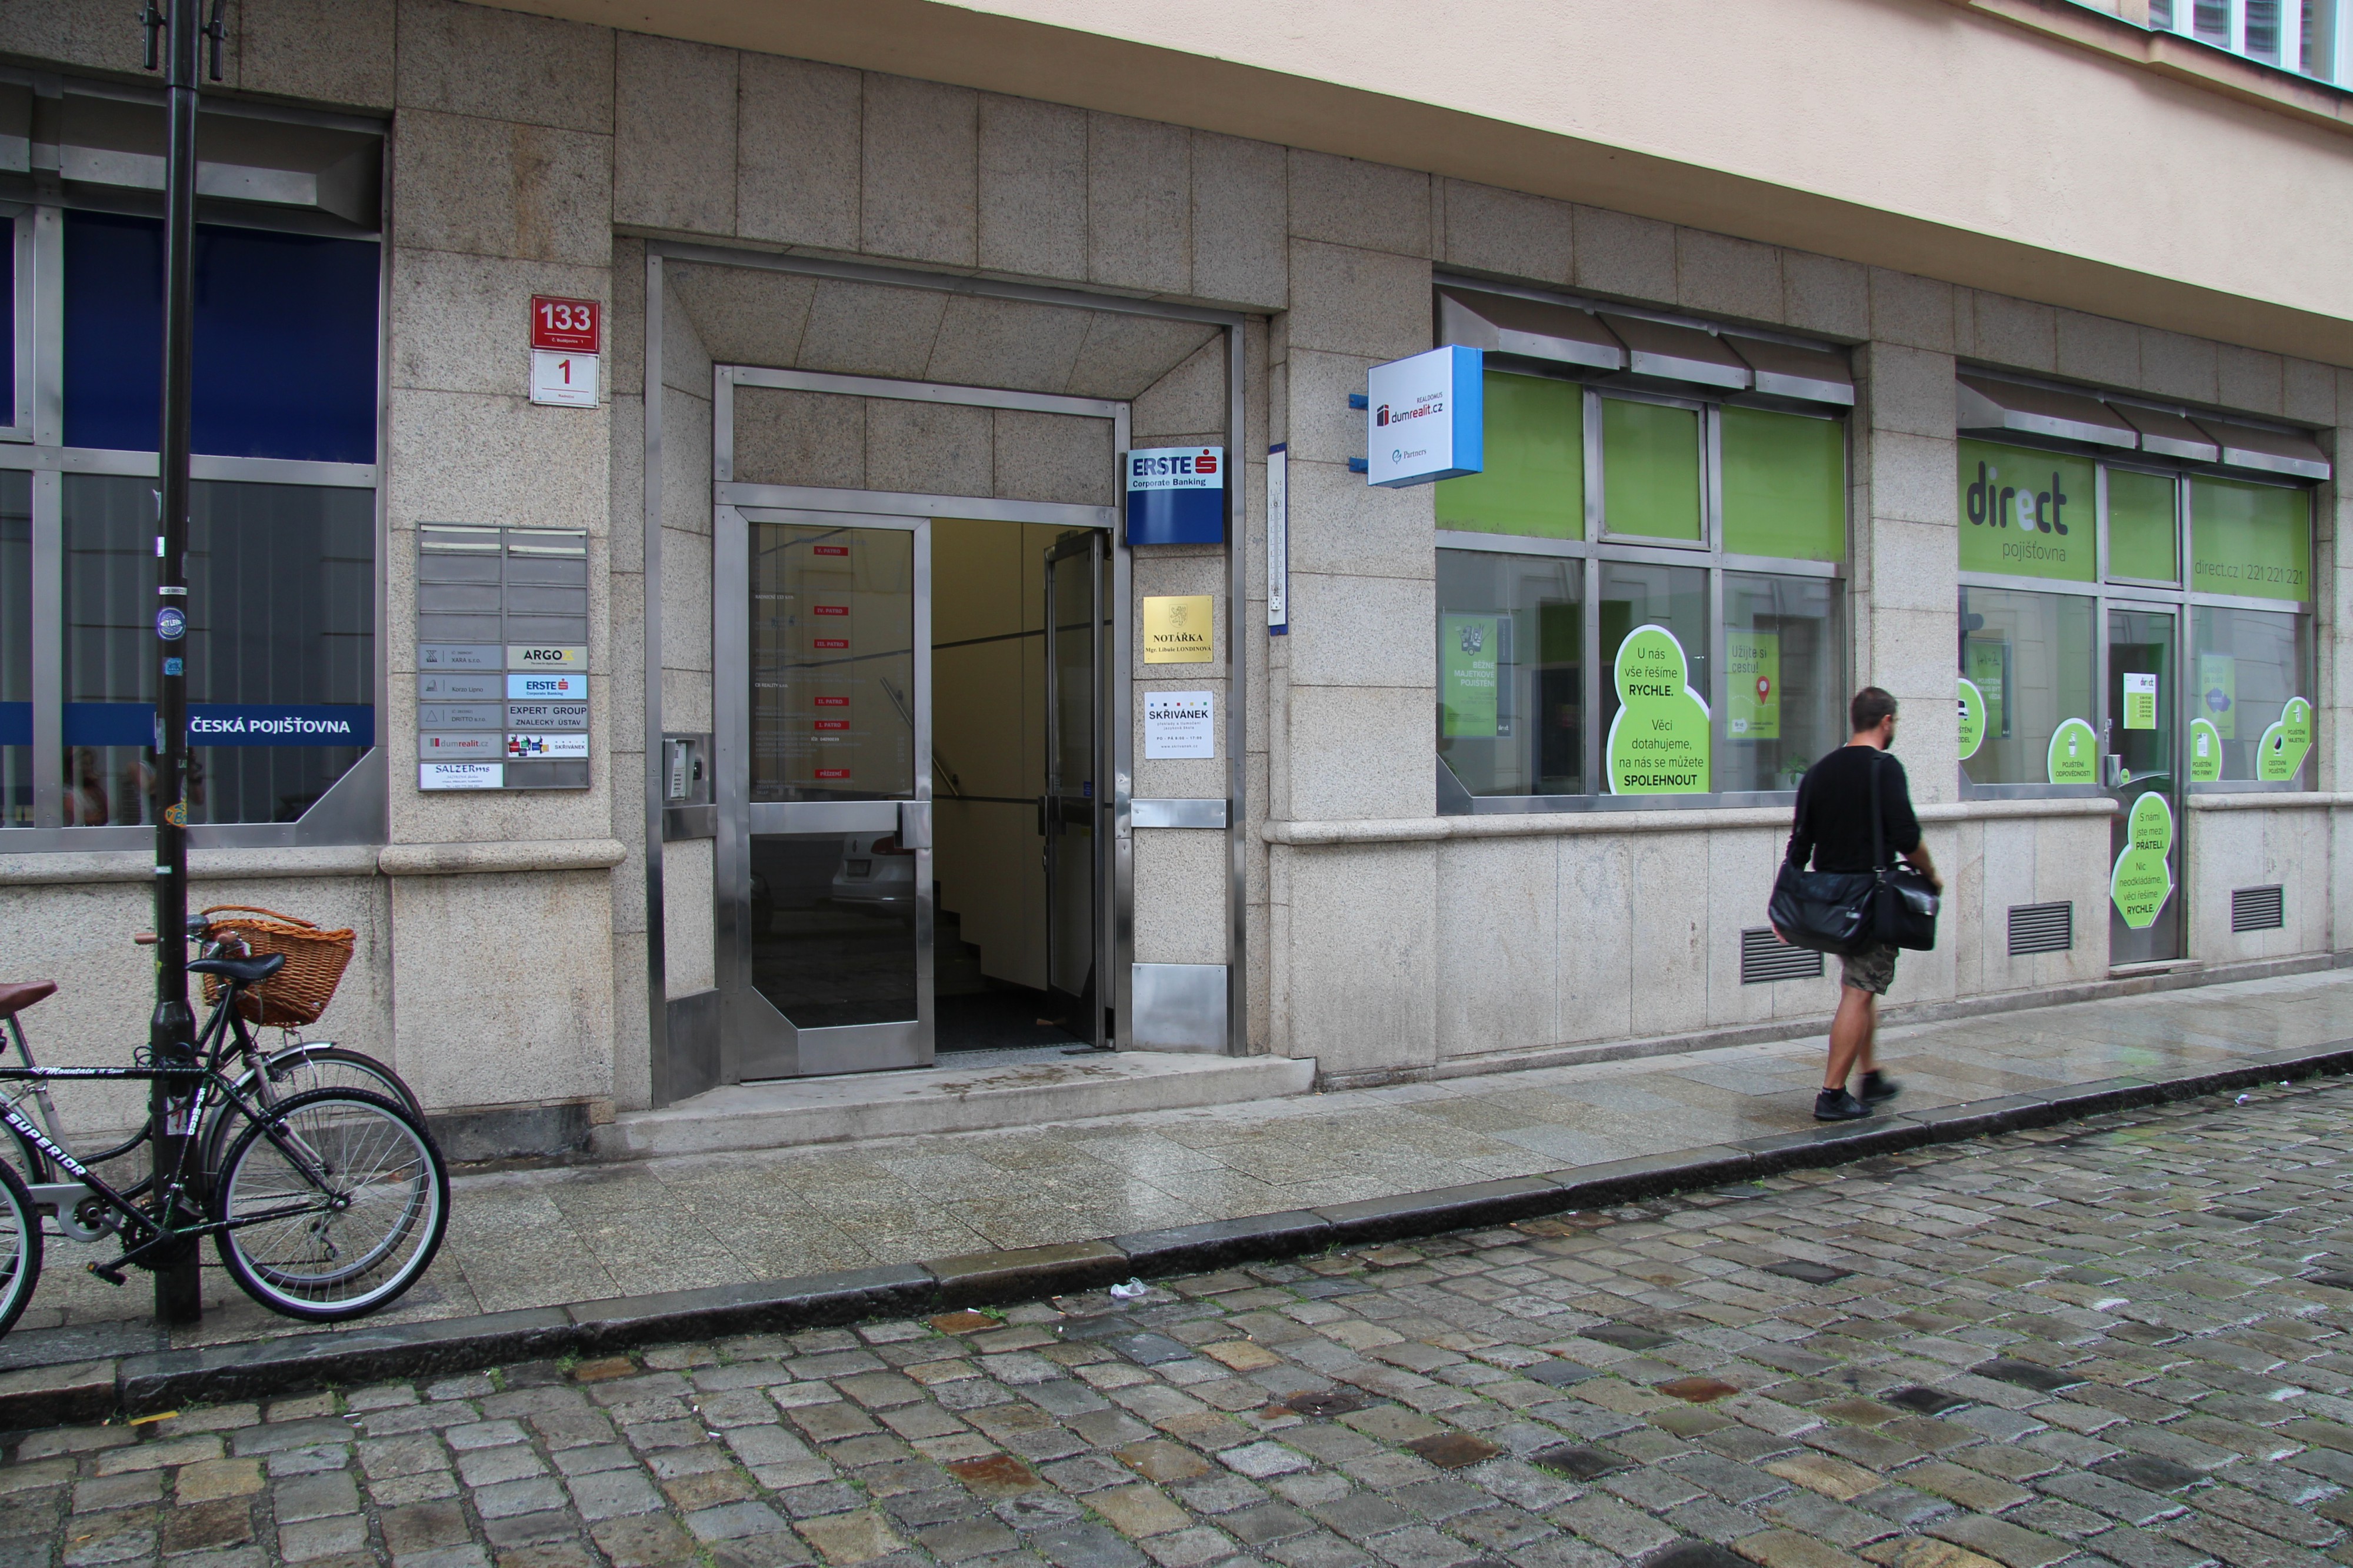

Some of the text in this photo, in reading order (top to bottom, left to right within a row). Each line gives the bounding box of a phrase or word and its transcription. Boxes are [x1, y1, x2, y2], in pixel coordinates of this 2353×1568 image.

[541, 303, 591, 331] 133
[558, 359, 571, 384] 1
[1417, 392, 1443, 404] REALDOMUS
[1392, 403, 1443, 423] dumrealit.cz
[1404, 449, 1427, 459] Partners
[1133, 456, 1191, 476] ERSTE
[1133, 478, 1206, 488] Corporate Banking
[1967, 461, 2068, 535] direct
[2003, 541, 2065, 562] pojišťovna
[2195, 559, 2302, 585] direct.cz 221 221 221
[1153, 632, 1203, 642] NOTÁŘKA
[1638, 648, 1665, 659] U nás
[1732, 645, 1767, 660] Užijte si
[1625, 665, 1677, 678] vše řešíme
[1732, 661, 1758, 673] cestu!
[526, 681, 556, 690] ERSTE
[1629, 684, 1674, 696] RYCHLE.
[1149, 709, 1208, 719] SKŘIVÁNEK
[191, 716, 350, 733] ČESKÁ POJIŠŤOVNA
[1652, 719, 1672, 730] Věci
[1632, 738, 1692, 752] dotahujeme,
[1619, 755, 1704, 768] na nás se můžete
[436, 765, 490, 773] SALZERms
[1624, 775, 1697, 786] SPOLEHNOUT
[2139, 812, 2159, 822] S námi
[2137, 826, 2162, 839] jste mezi
[2136, 839, 2164, 850] PŘÁTELI.
[2136, 862, 2146, 871] Nic
[2119, 875, 2162, 887] neodkládáme,
[2124, 890, 2158, 901] věci řešíme
[2127, 903, 2154, 915] RYCHLE.
[5, 1113, 87, 1176] SUPERIOR
